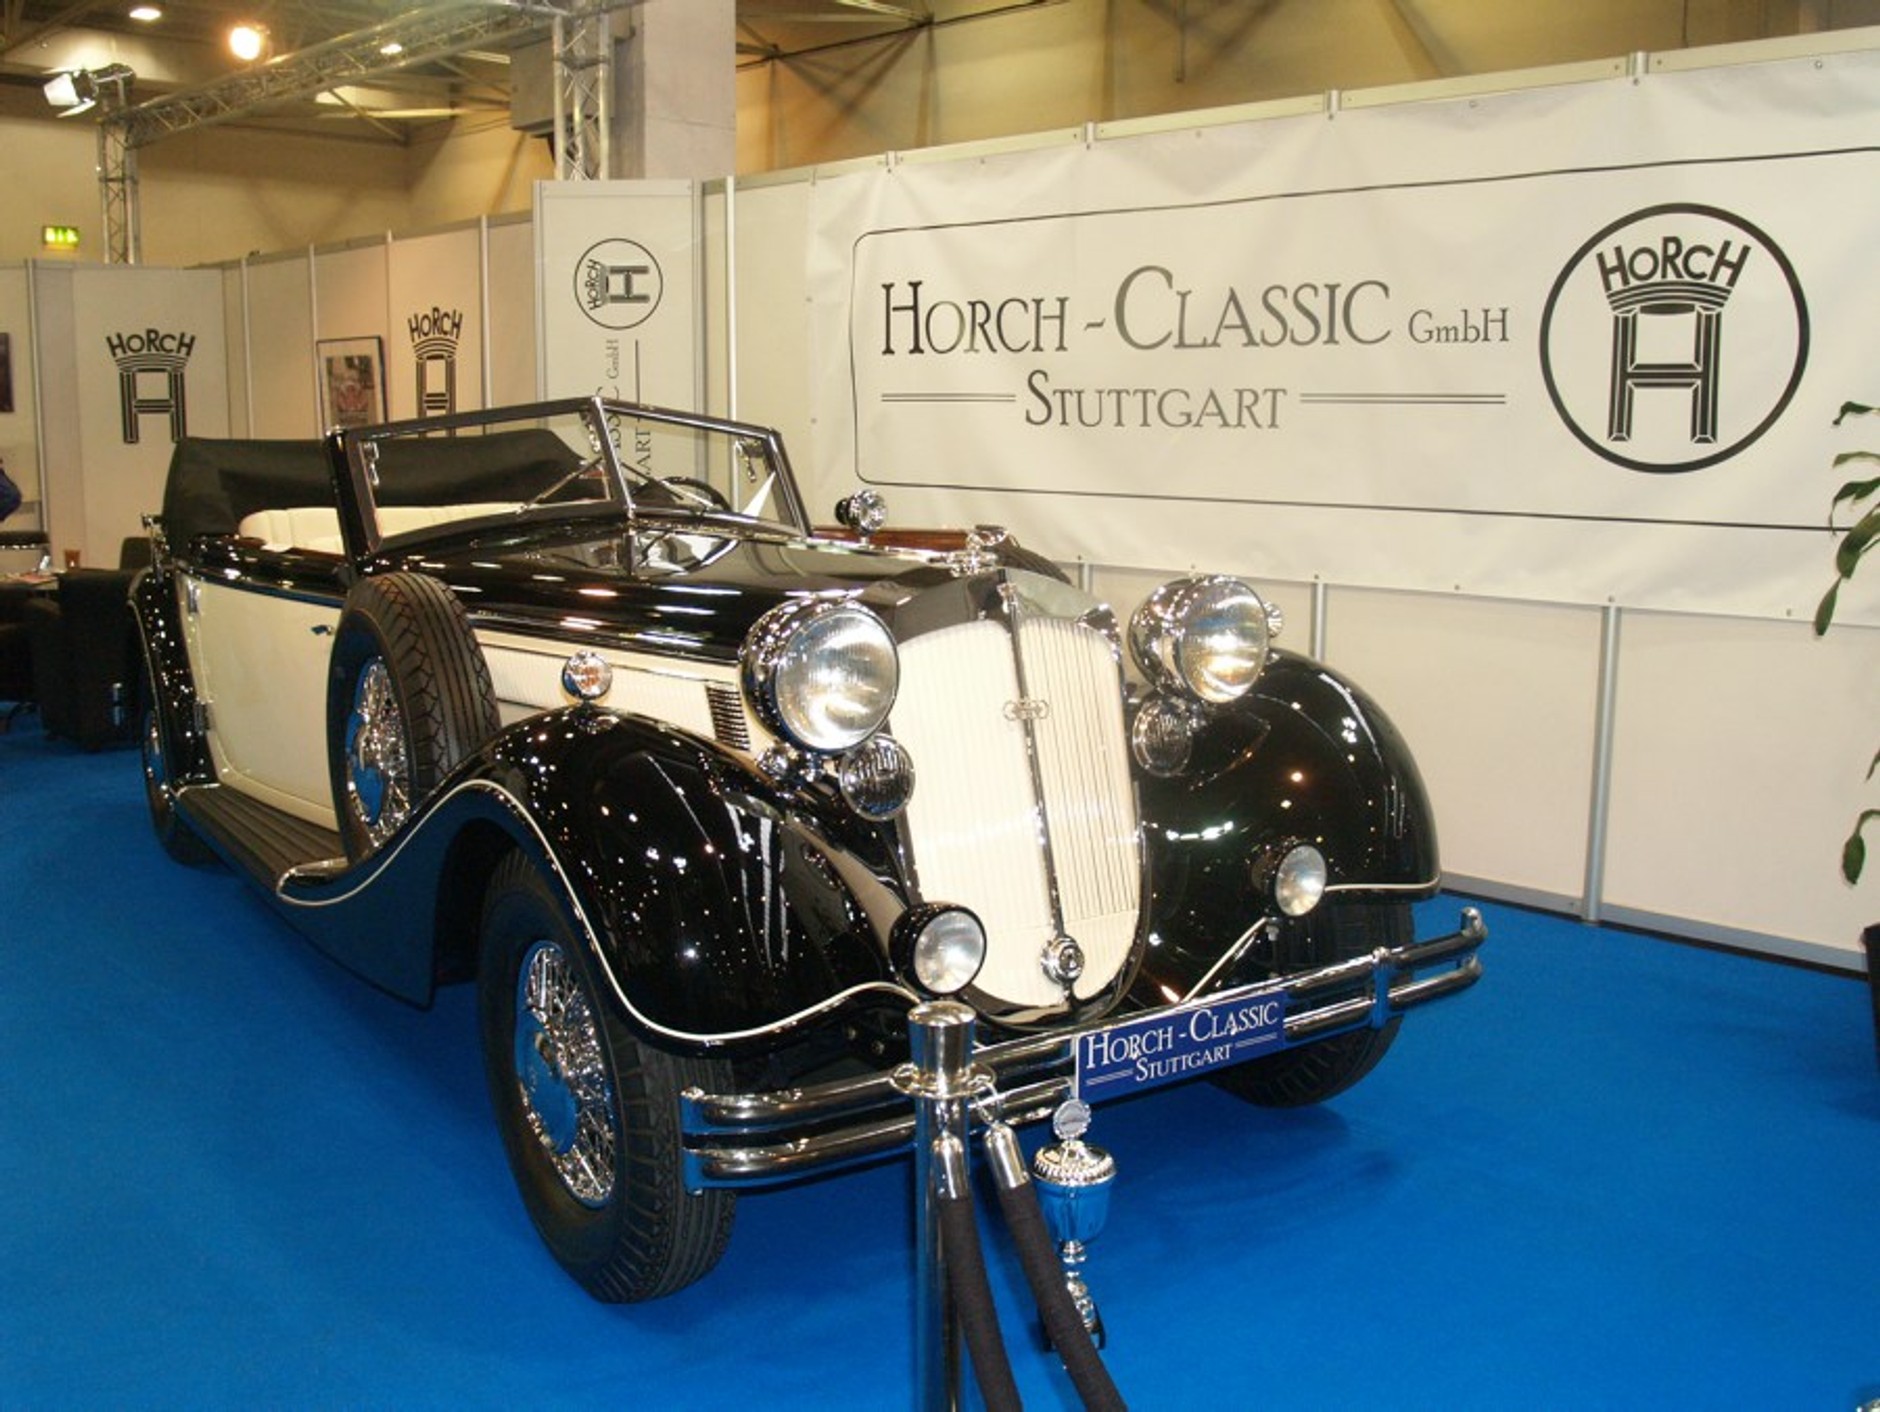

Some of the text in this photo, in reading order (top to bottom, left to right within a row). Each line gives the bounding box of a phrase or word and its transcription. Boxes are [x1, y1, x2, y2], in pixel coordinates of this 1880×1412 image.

[1596, 235, 1752, 292] HORCH
[407, 306, 463, 343] HORCH
[881, 280, 1070, 355] HORCH
[1408, 307, 1510, 344] GmbH
[105, 328, 196, 358] HORCH
[1025, 369, 1288, 429] STUTTGART
[1085, 1025, 1174, 1069] HORCH
[1134, 1043, 1234, 1083] STUTTGART
